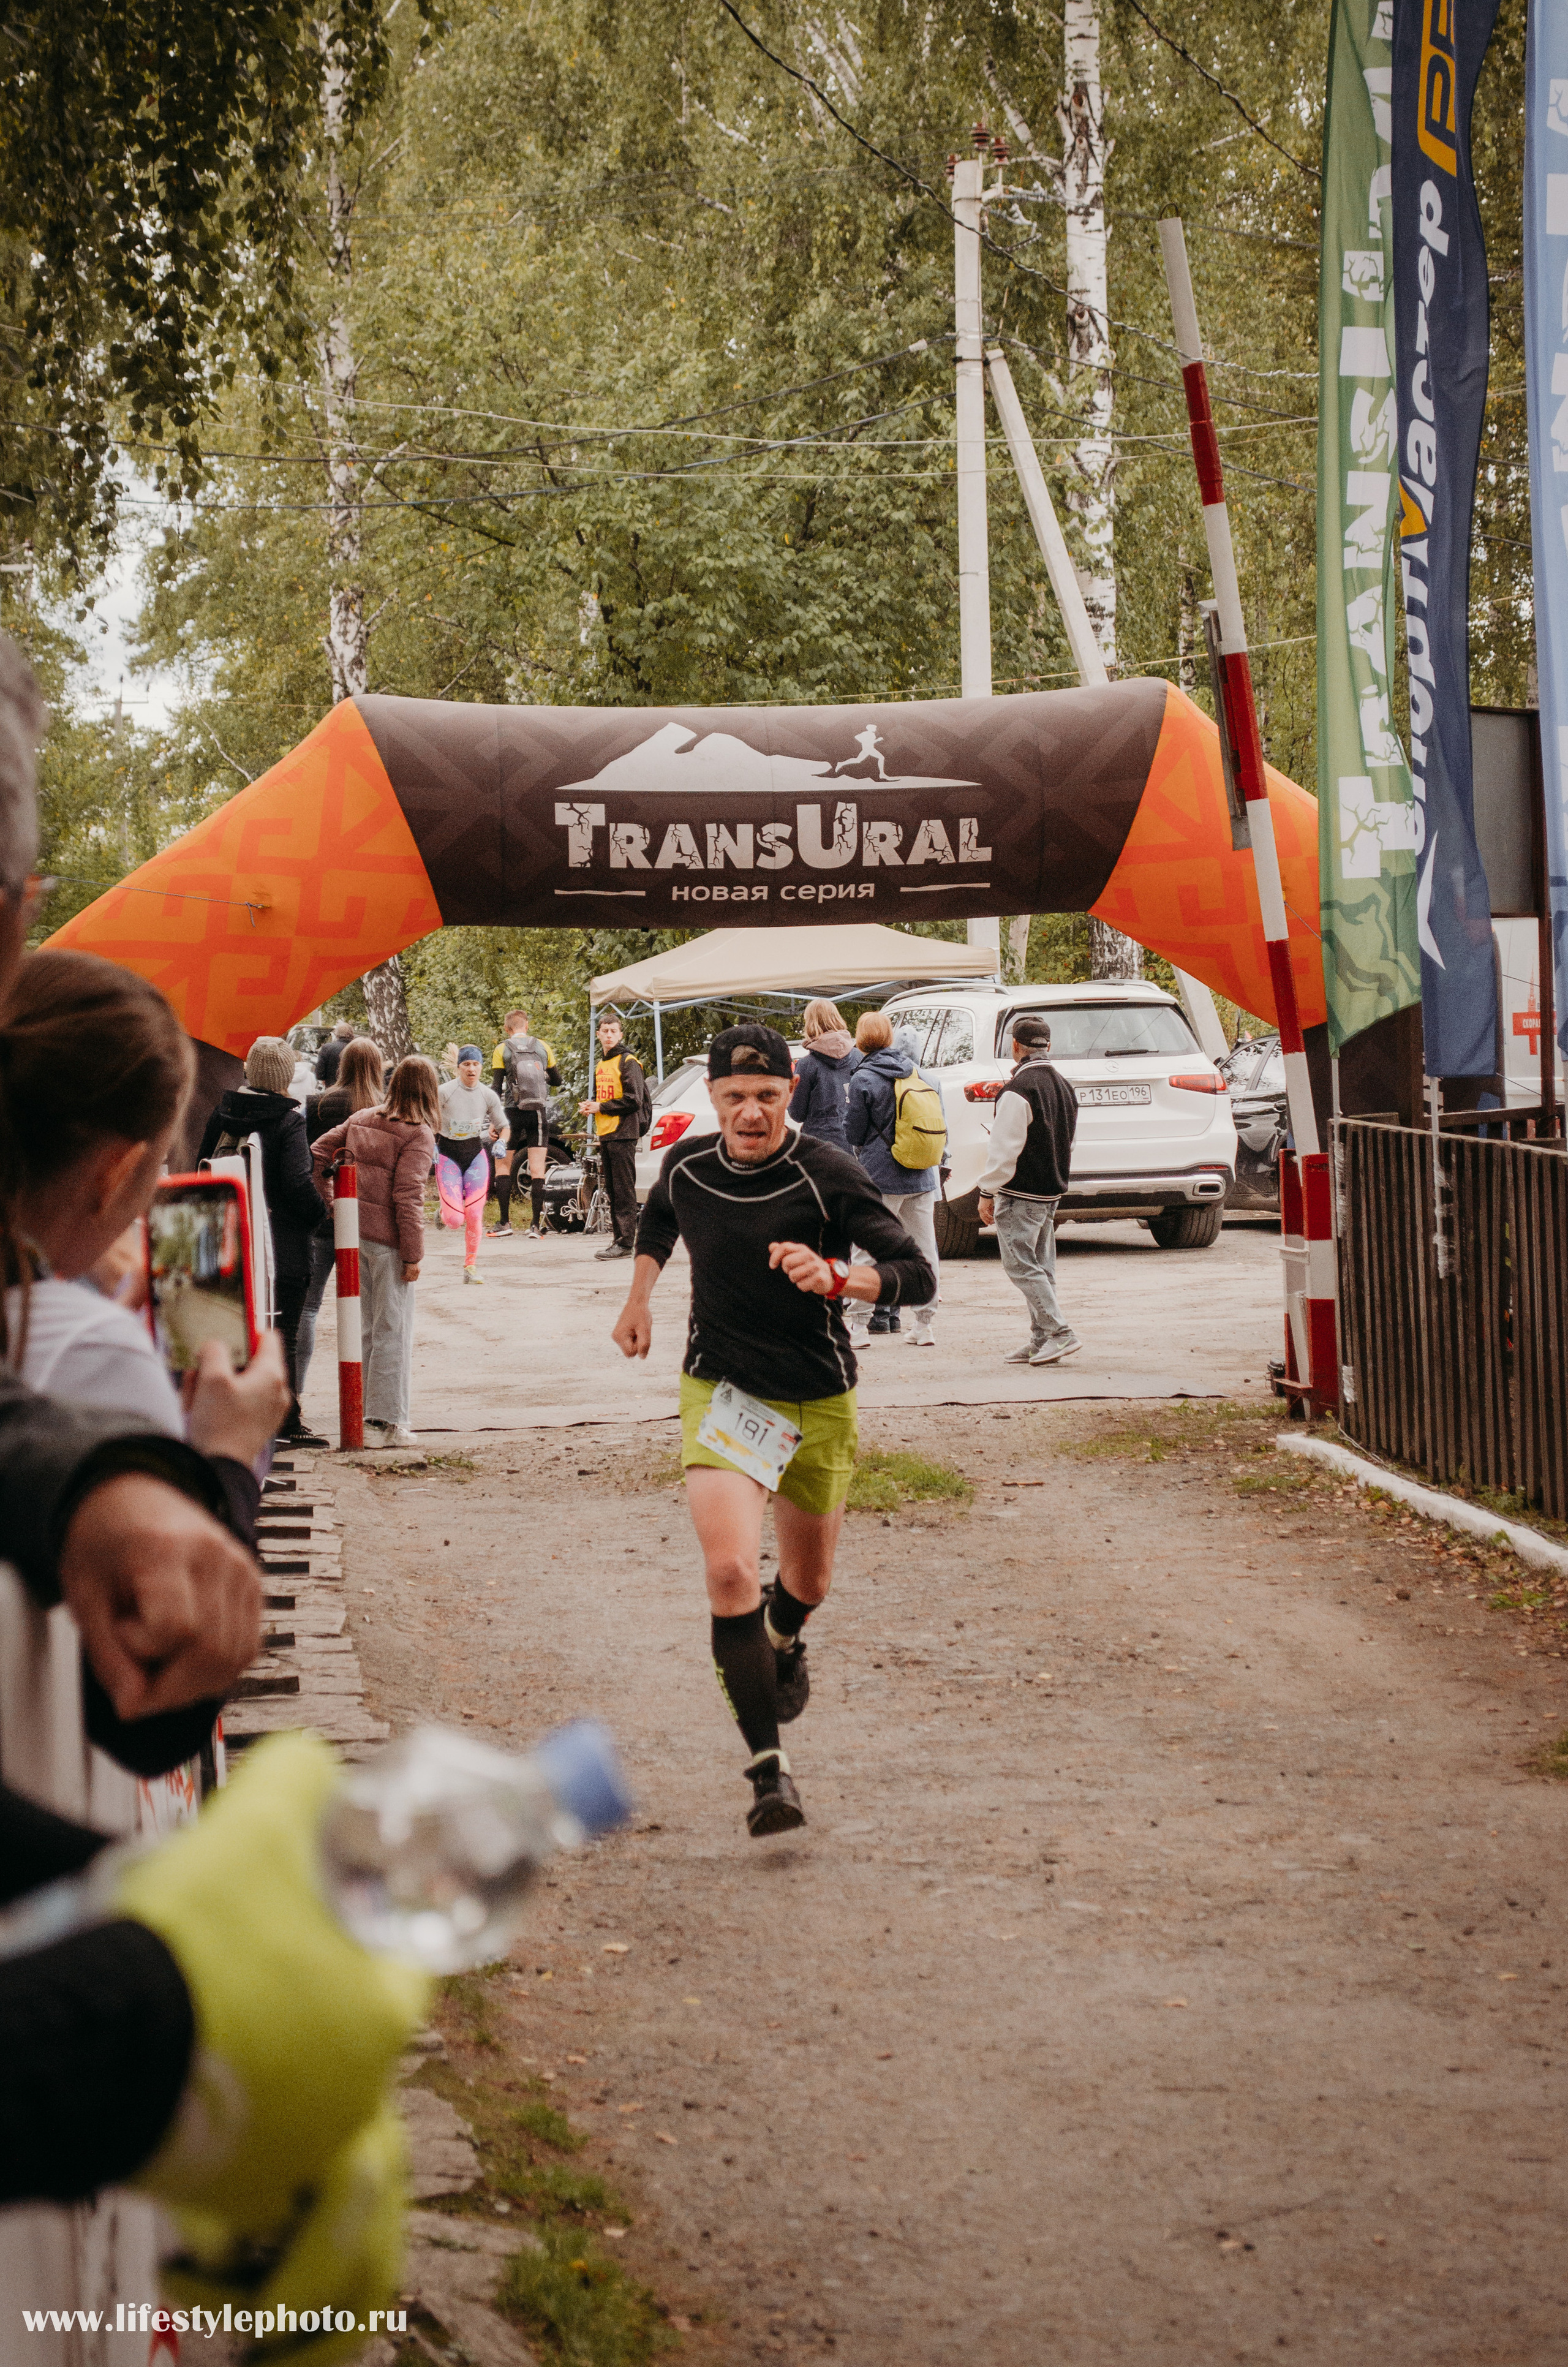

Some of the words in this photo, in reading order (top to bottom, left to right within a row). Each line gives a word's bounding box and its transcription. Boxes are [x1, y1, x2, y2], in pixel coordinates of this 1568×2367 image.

[671, 885, 768, 901] новая
[780, 883, 875, 903] серия
[1129, 1087, 1147, 1096] 196
[735, 1413, 768, 1446] 181
